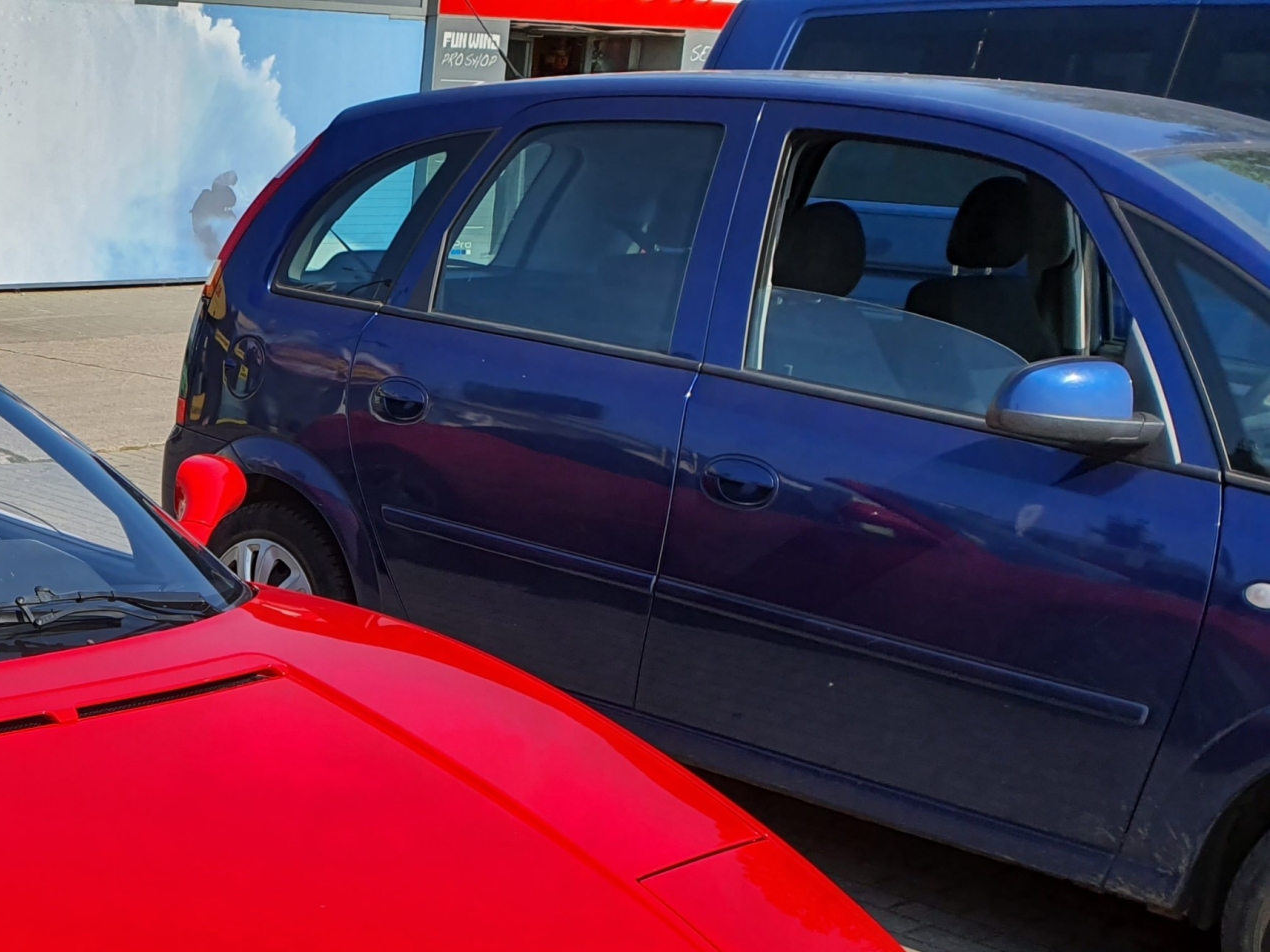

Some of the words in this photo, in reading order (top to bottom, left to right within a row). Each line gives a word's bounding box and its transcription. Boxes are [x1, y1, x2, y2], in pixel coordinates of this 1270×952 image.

[442, 31, 468, 49] FUN
[441, 51, 464, 67] PRO
[464, 52, 498, 69] SHOP
